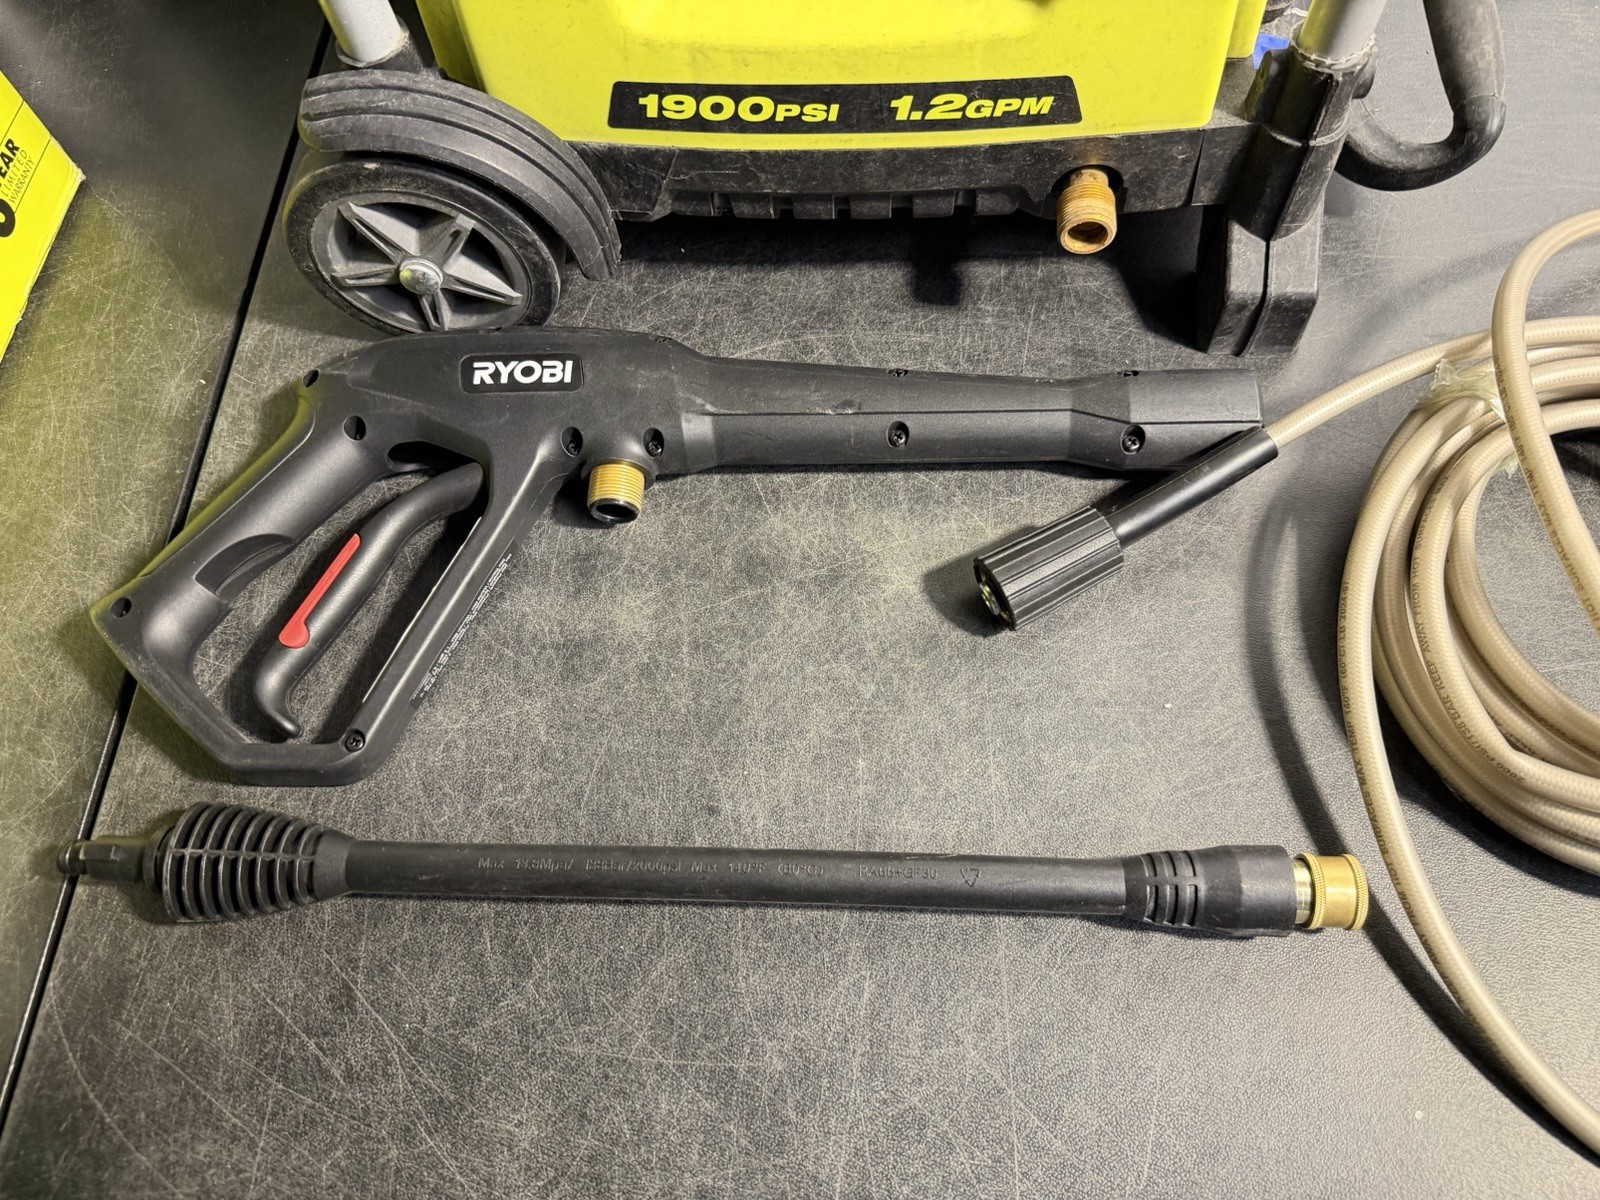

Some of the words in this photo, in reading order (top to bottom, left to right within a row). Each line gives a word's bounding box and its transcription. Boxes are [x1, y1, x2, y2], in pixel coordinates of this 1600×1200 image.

[637, 92, 840, 123] 1900PSI
[889, 92, 1055, 121] 1.2GPM
[0, 138, 20, 187] EAR
[1, 149, 28, 197] LIMITED
[8, 156, 35, 203] WARRANTY
[472, 360, 574, 385] RYOBI
[1414, 497, 1437, 551] SURFACES
[1412, 556, 1420, 580] HOT
[1549, 530, 1584, 592] SURFACES
[1411, 582, 1422, 618] FROM
[1338, 625, 1346, 641] LB
[1416, 621, 1432, 653] AWAY
[1426, 660, 1446, 692] KEEP
[1340, 686, 1353, 715] 140°F
[1440, 694, 1462, 721] BAR
[1346, 721, 1359, 752] TEMP
[1354, 759, 1368, 786] MAX
[1494, 761, 1526, 783] 2000
[1363, 790, 1389, 855] SURFACES
[477, 856, 505, 869] Max
[690, 861, 718, 873] Max
[727, 862, 767, 874] 140°F
[858, 865, 939, 880] PA66+GF30
[1387, 862, 1401, 886] HOT
